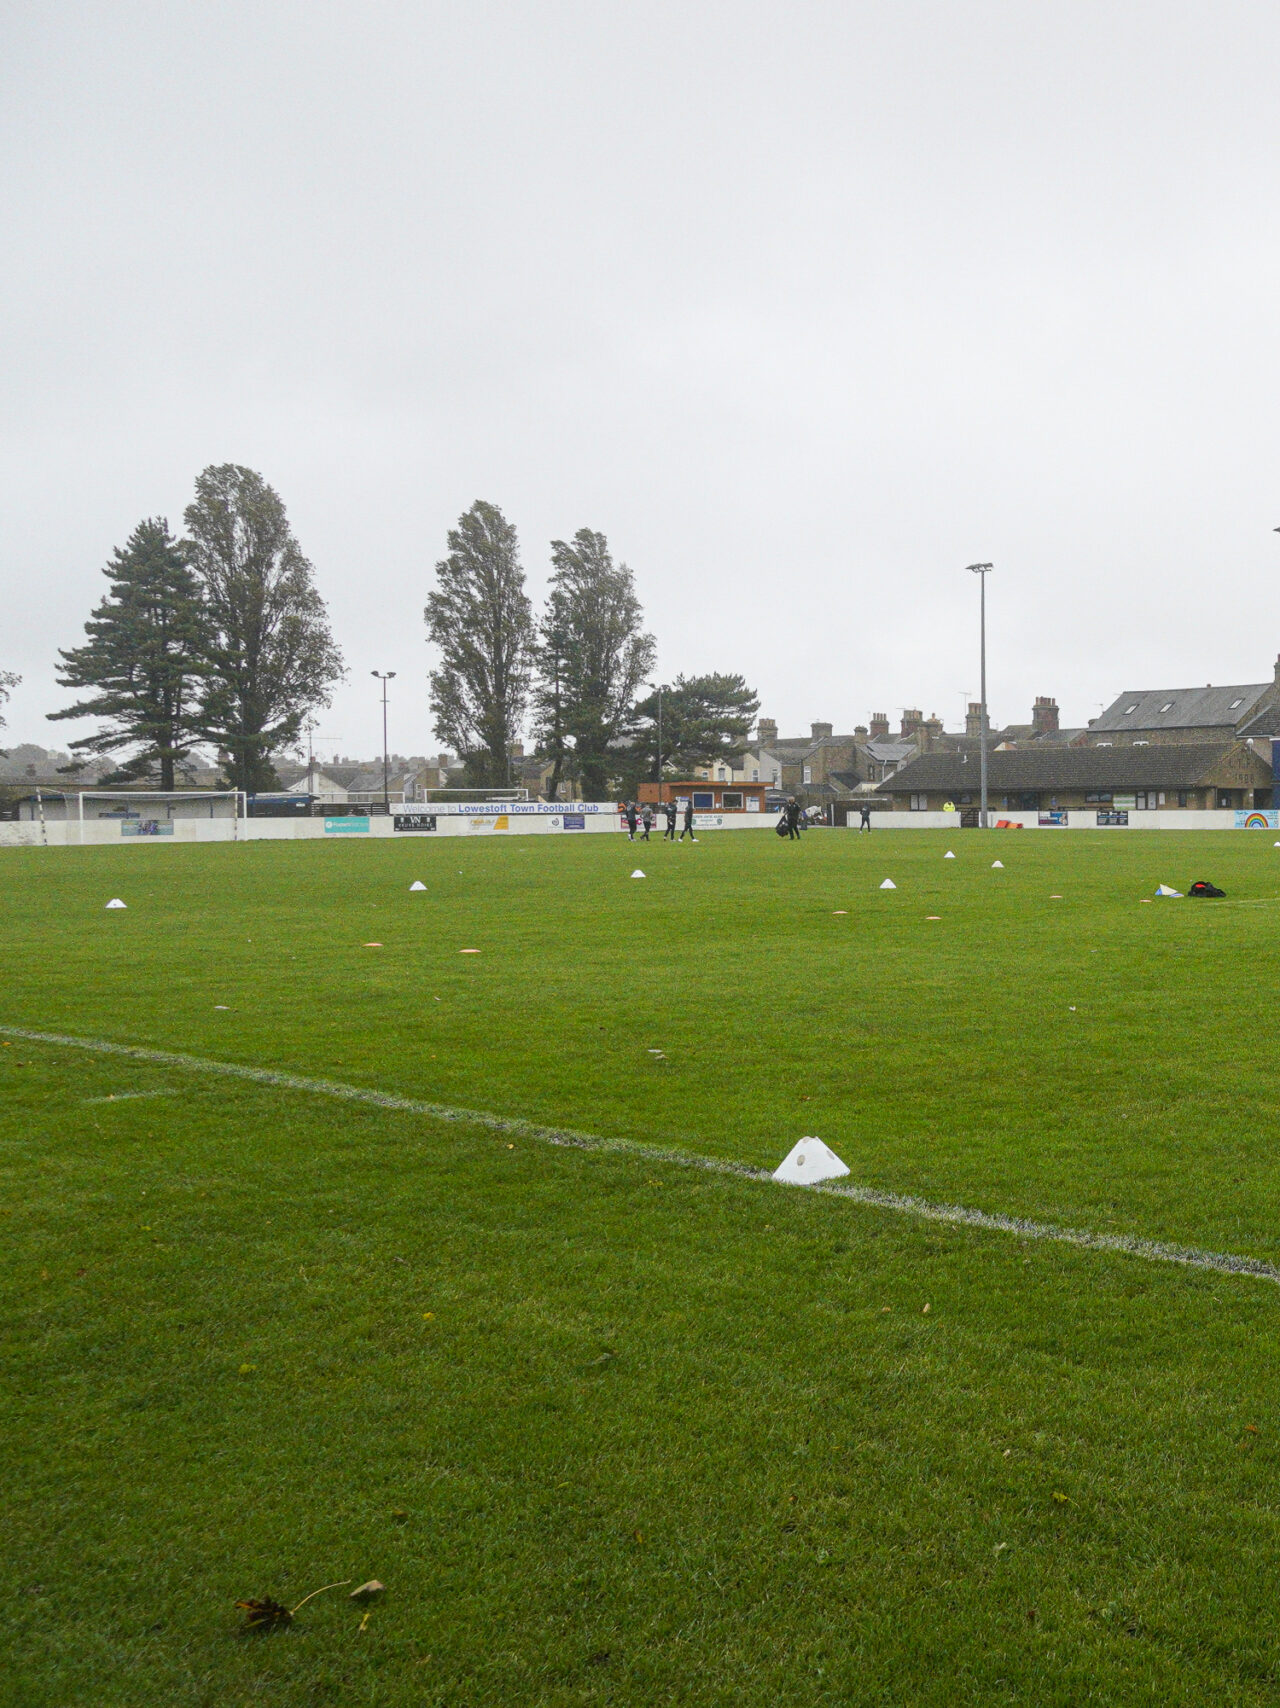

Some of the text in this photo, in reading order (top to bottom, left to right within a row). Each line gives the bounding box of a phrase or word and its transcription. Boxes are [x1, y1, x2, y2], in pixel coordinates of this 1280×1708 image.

[402, 803, 599, 813] Welcome to Lowestoft Town Football Club
